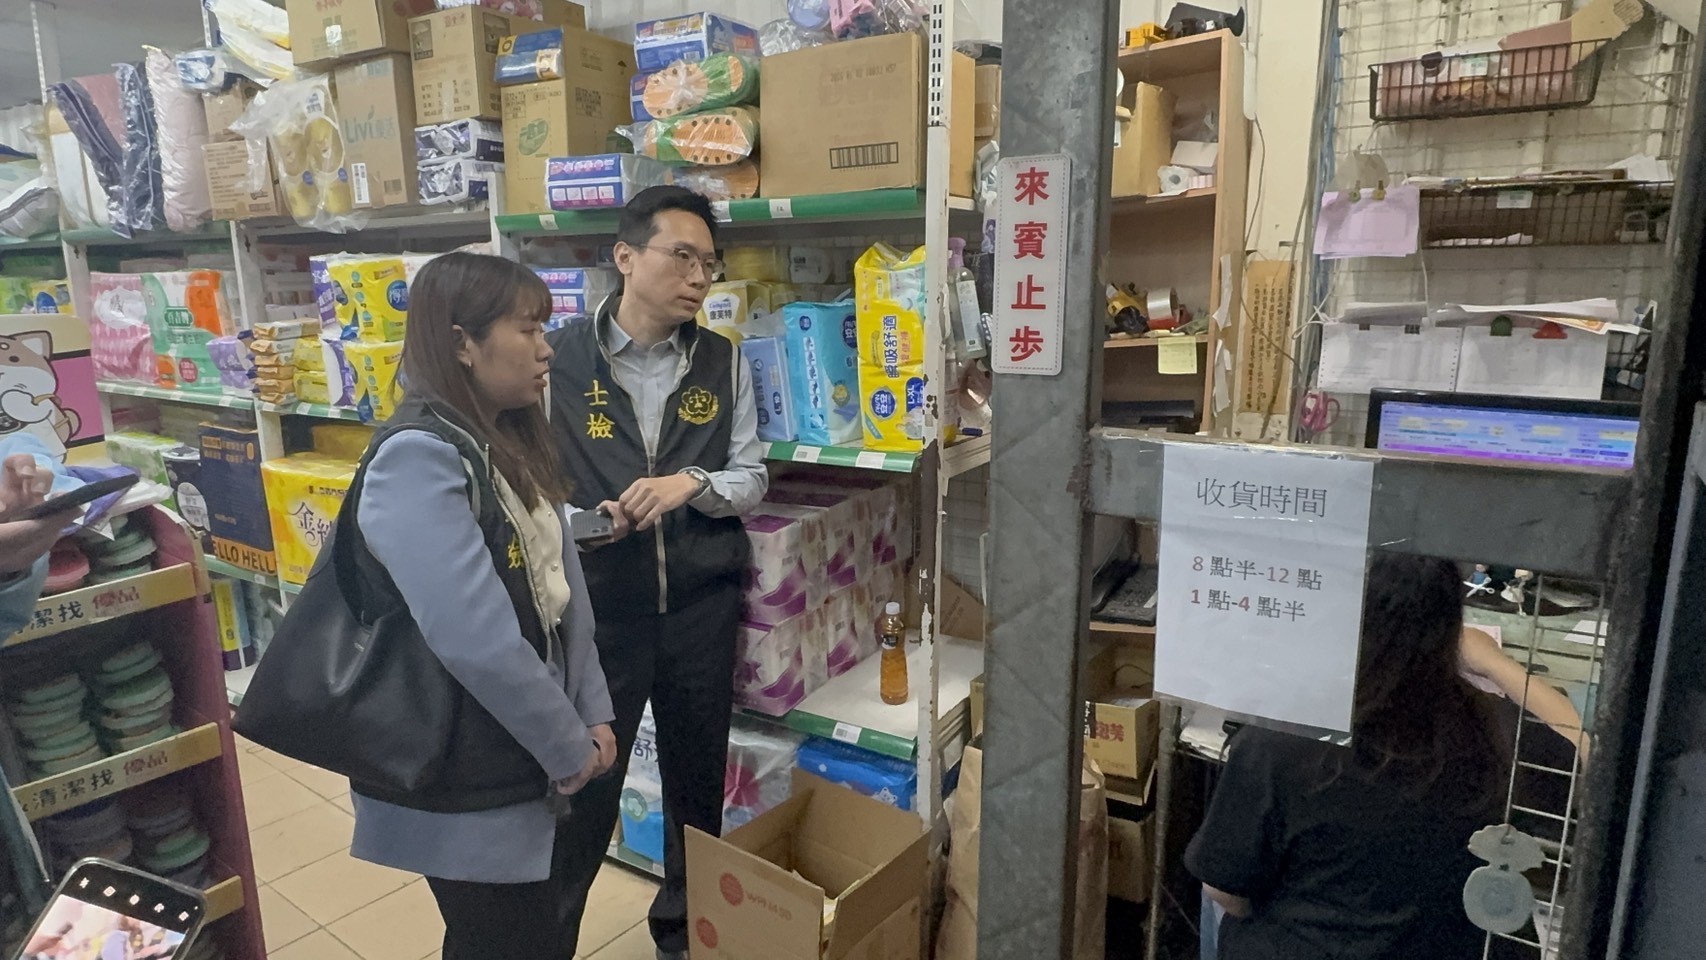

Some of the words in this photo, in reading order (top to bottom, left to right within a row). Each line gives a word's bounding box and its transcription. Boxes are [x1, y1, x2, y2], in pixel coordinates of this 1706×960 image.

[1009, 166, 1050, 363] 來賓止步
[883, 315, 900, 378] 瞬吸舒適
[584, 380, 615, 439] 士檢
[1197, 477, 1328, 518] 收貨時間
[242, 548, 277, 574] HELL
[1192, 555, 1204, 572] 8
[1296, 568, 1323, 591] 點
[1191, 589, 1201, 604] 1
[1257, 595, 1306, 622] 點半
[634, 737, 659, 762] 舒
